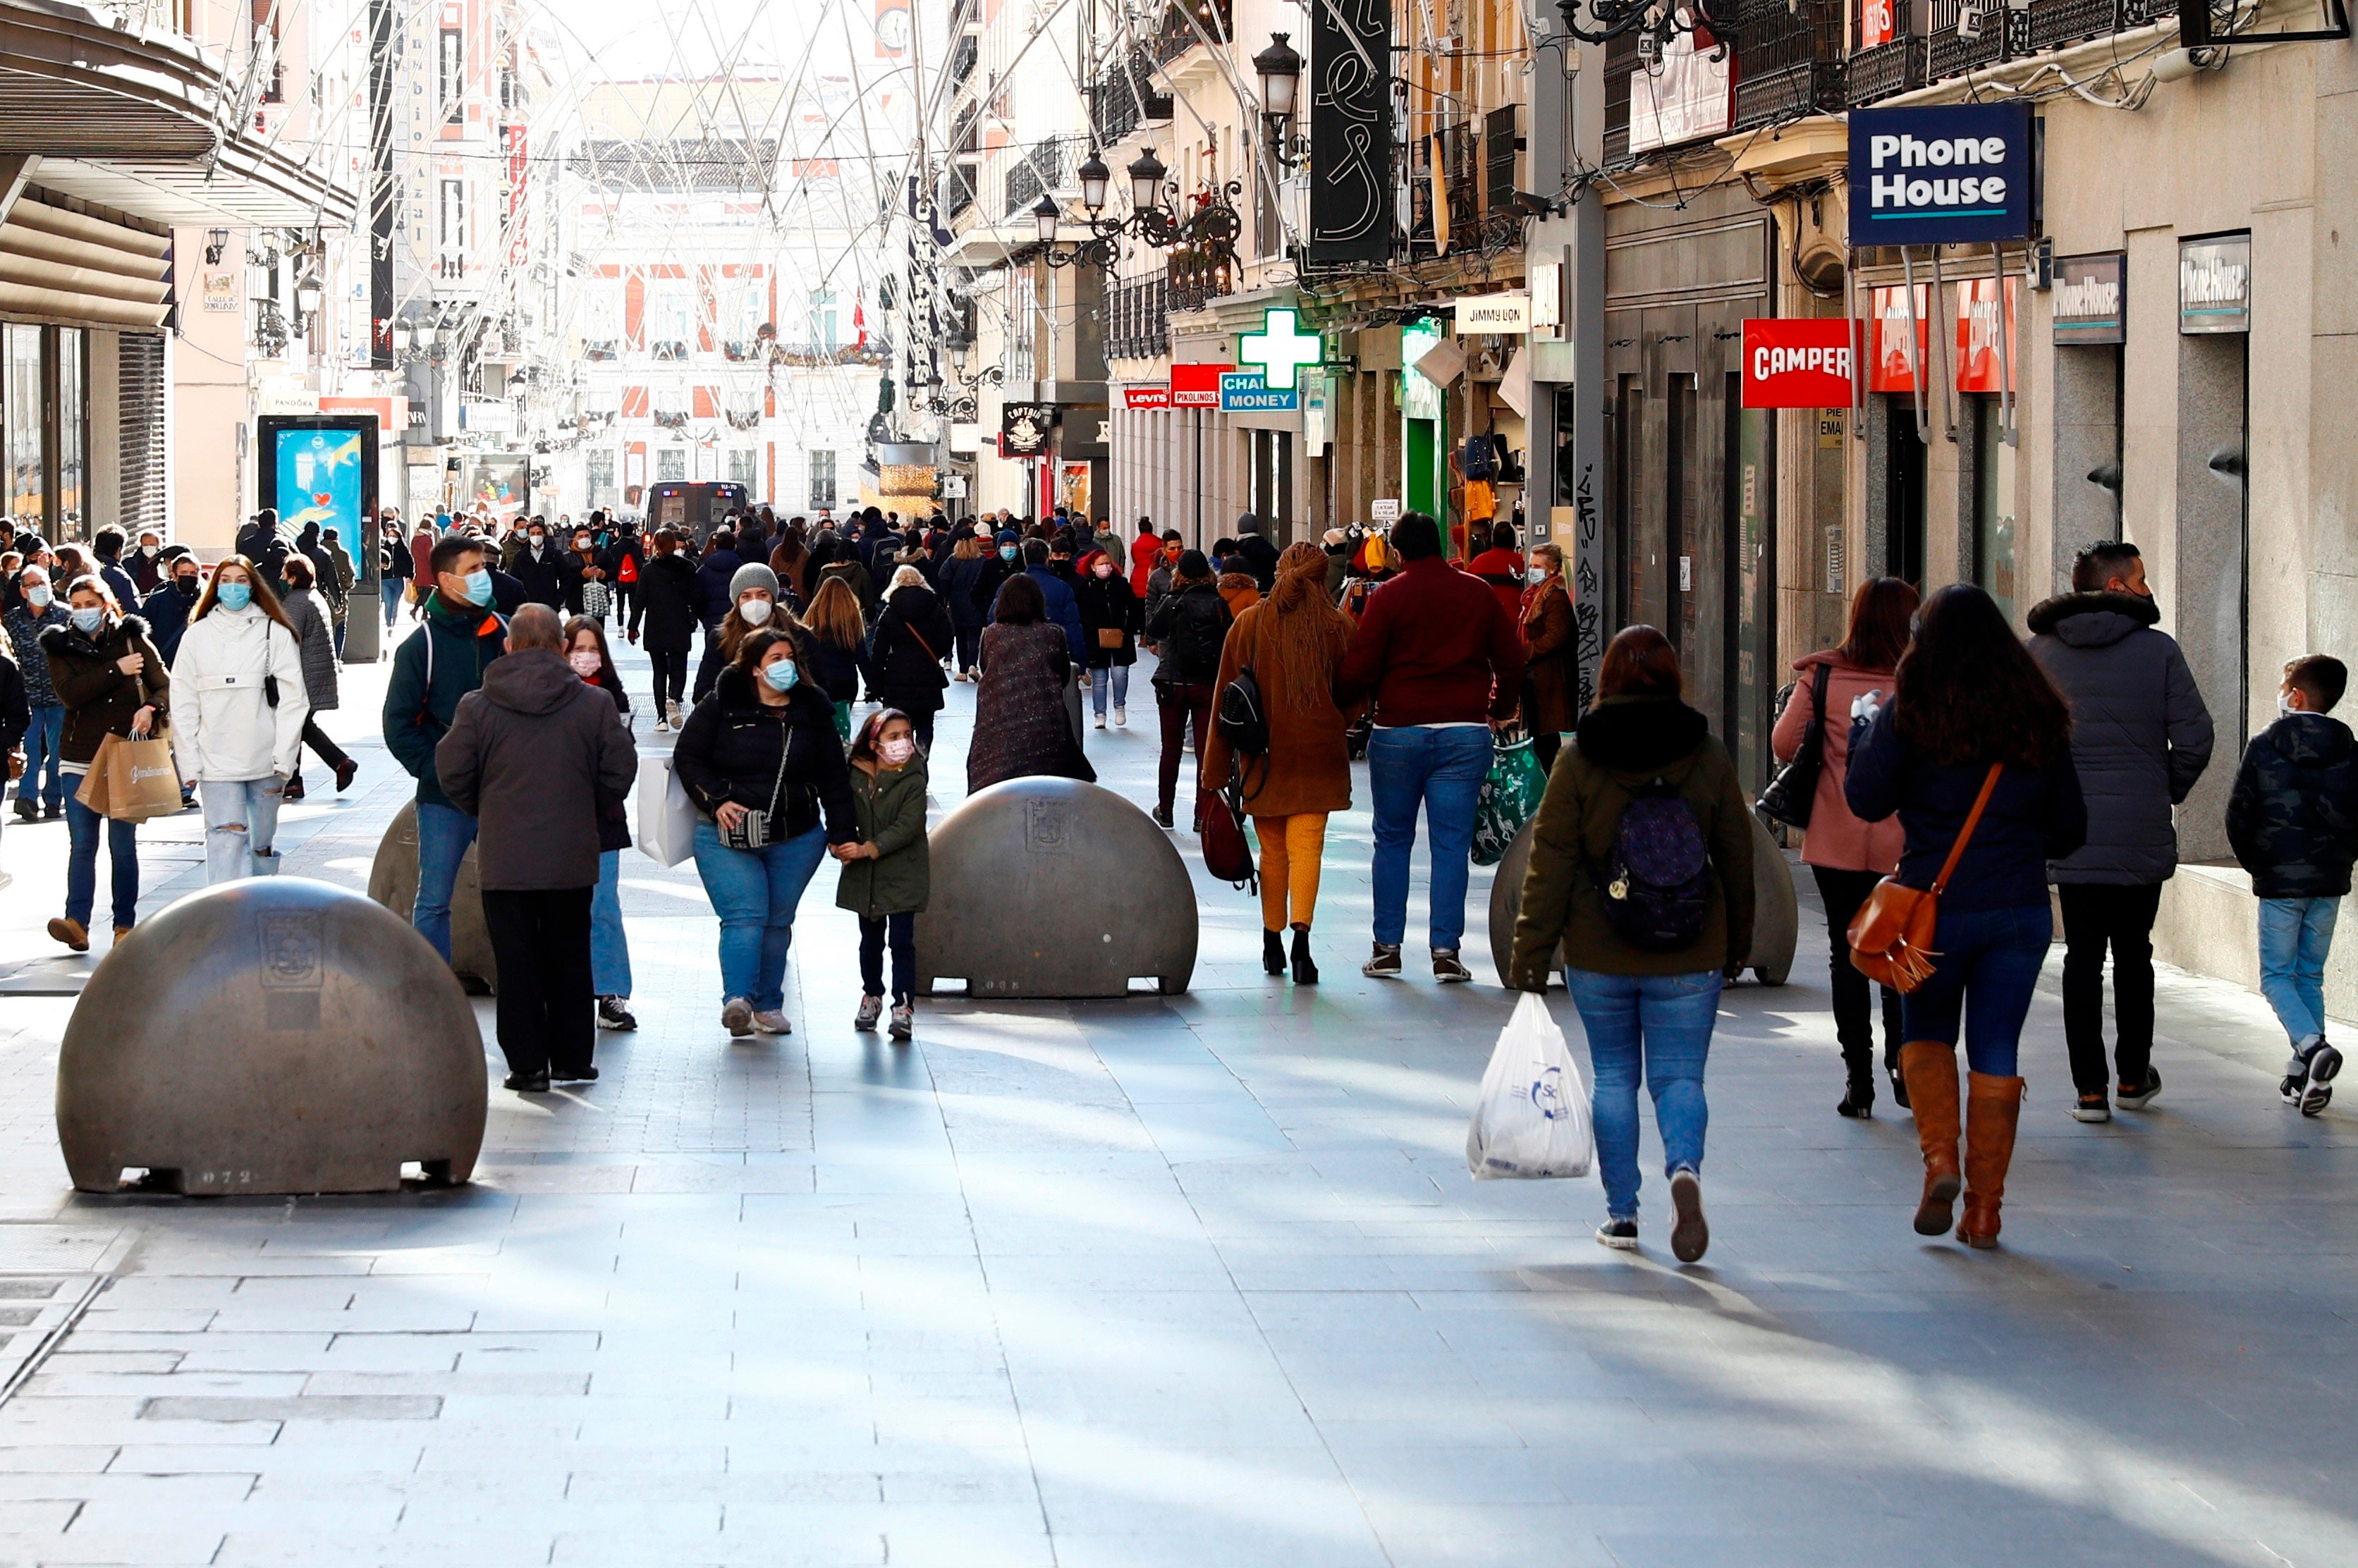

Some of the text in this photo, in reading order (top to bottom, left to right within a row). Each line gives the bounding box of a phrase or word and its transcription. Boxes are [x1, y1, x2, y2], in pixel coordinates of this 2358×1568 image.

[350, 30, 362, 43] 15
[1871, 134, 2006, 168] Phone
[1871, 175, 2007, 207] House
[1754, 346, 1852, 381] CAMPER
[1223, 377, 1264, 390] CHA
[1177, 393, 1214, 402] PIKOLINOS
[1229, 395, 1290, 407] MONEY
[408, 411, 426, 424] ARA
